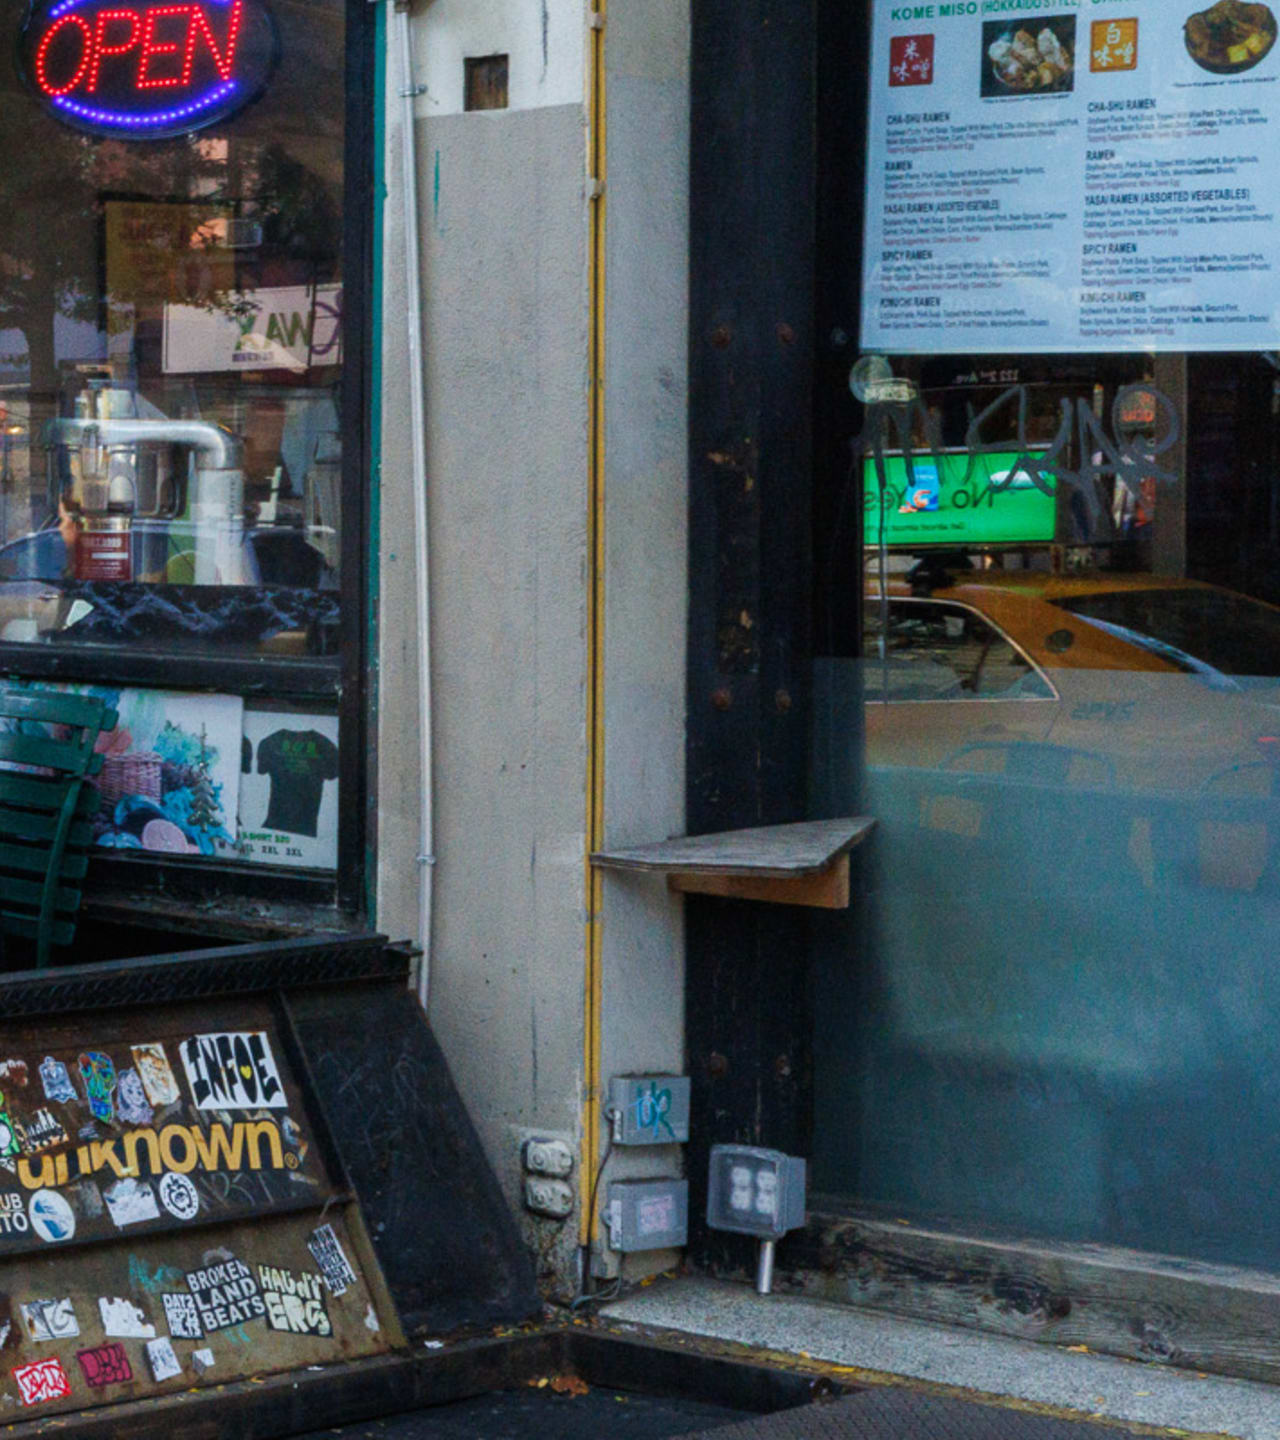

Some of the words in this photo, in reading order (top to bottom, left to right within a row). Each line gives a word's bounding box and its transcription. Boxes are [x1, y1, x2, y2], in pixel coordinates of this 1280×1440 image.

[891, 7, 934, 21] KOME
[939, 2, 977, 16] MISO
[37, 0, 241, 96] OPEN
[1107, 22, 1121, 44] 白
[187, 1260, 250, 1292] BROKEN
[194, 1278, 257, 1310] LAND
[202, 1295, 265, 1330] BEATS
